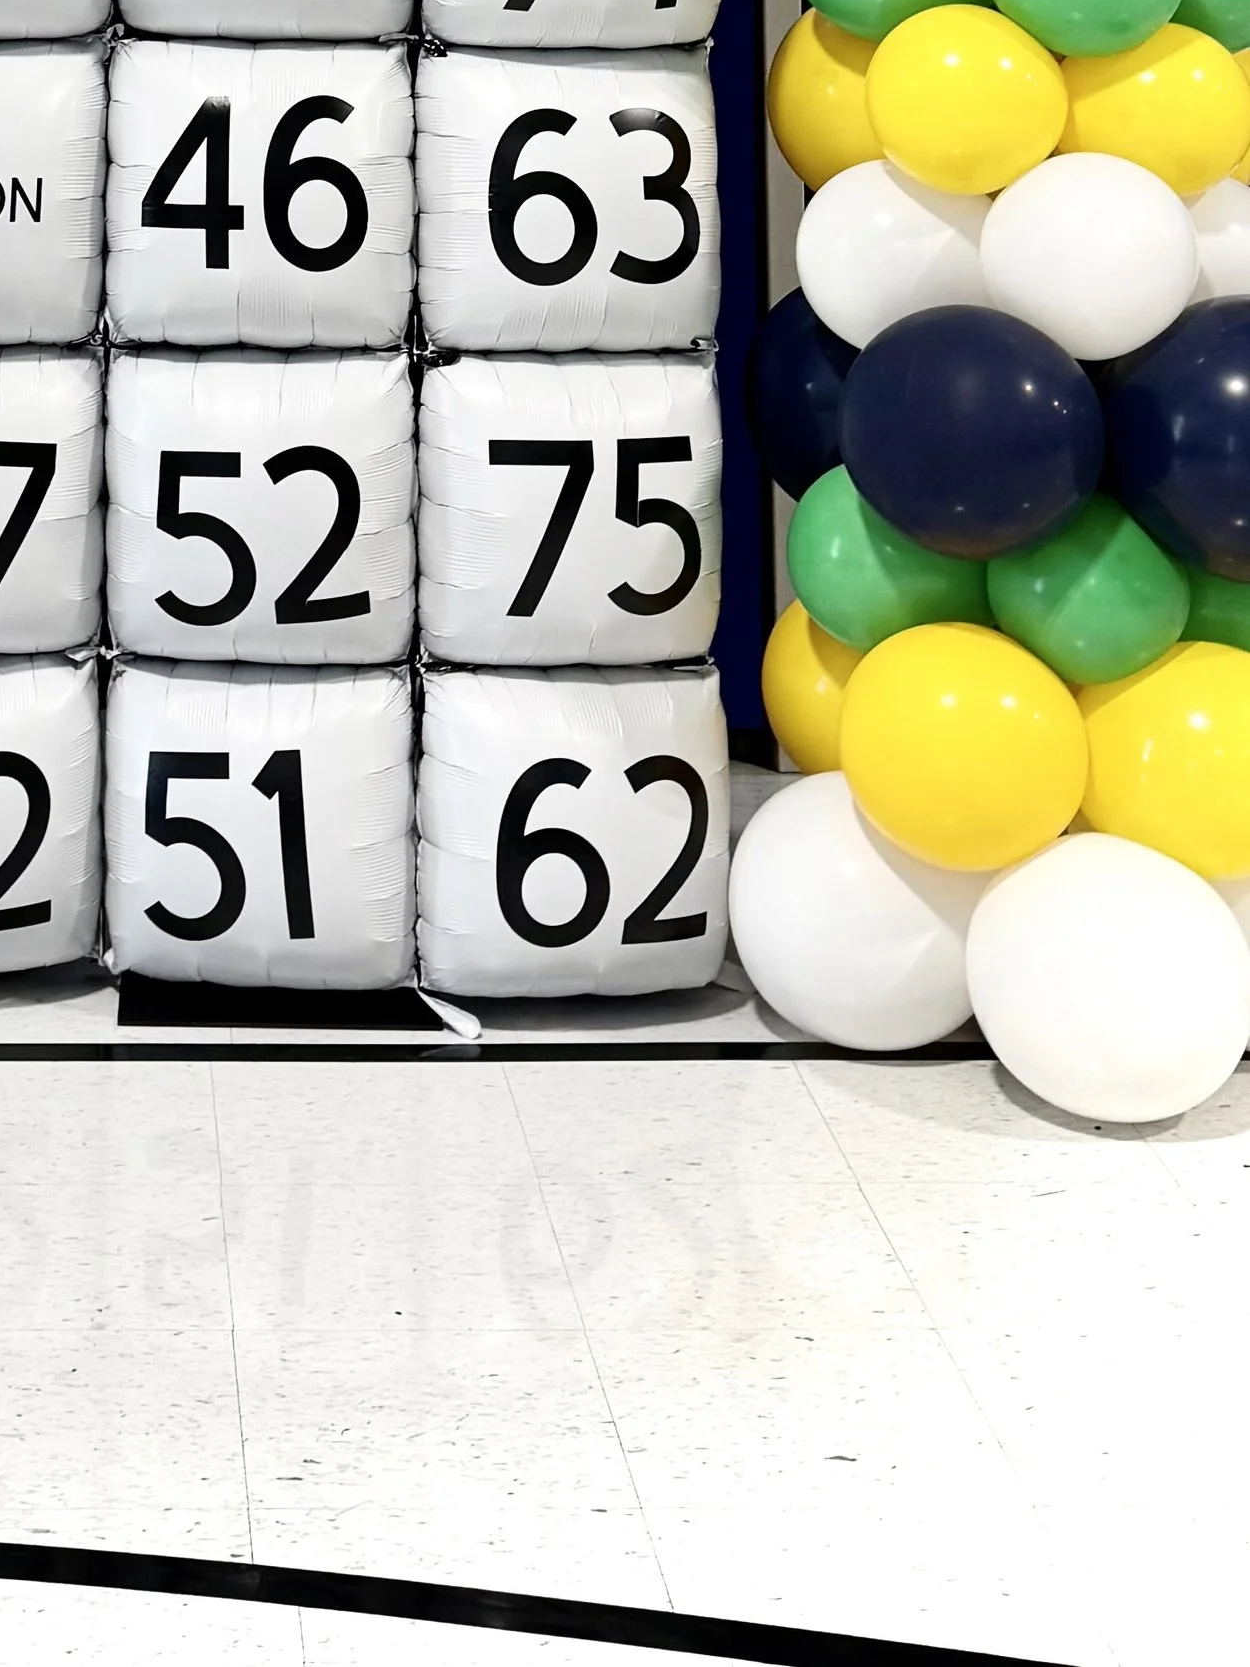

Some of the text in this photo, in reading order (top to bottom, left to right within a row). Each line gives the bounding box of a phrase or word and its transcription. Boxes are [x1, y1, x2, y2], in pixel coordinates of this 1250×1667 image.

[141, 95, 700, 286] 46 63
[155, 446, 370, 626] 52
[489, 436, 701, 617] 75
[144, 750, 315, 941] 51
[496, 755, 708, 947] 62
